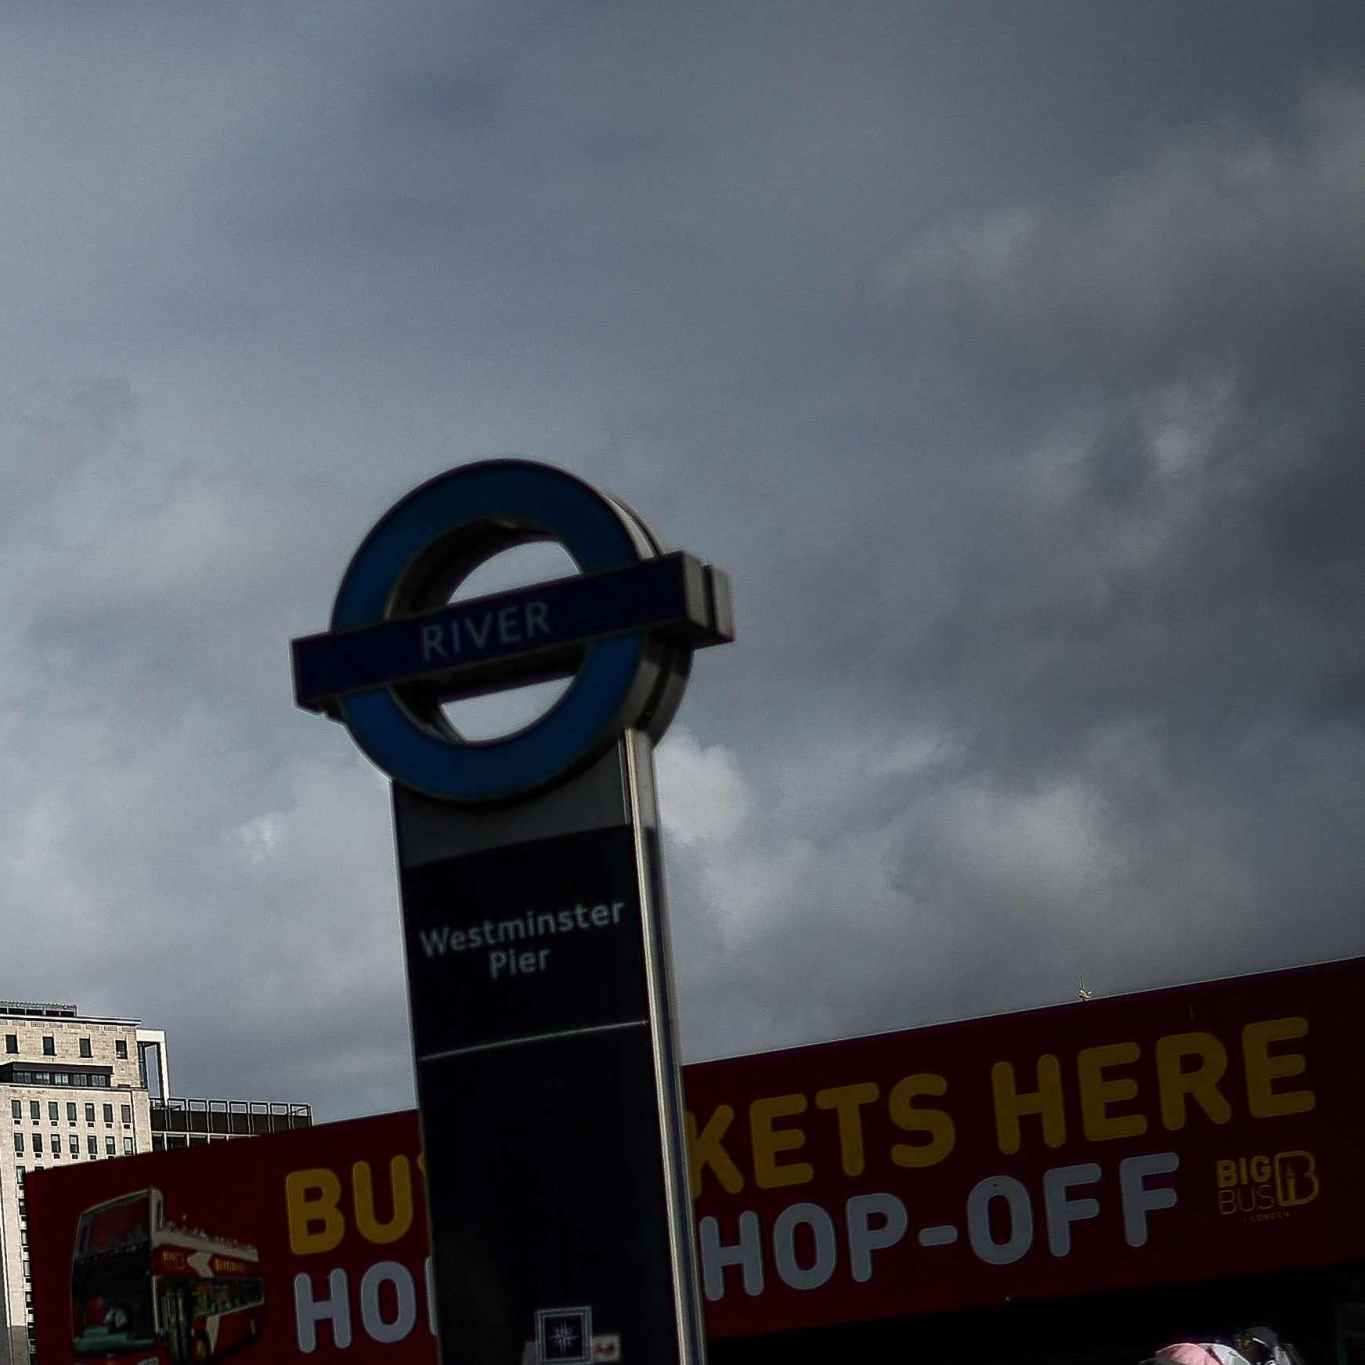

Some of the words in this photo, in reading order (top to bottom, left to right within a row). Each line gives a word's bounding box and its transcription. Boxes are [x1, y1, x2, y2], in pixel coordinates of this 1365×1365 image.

[420, 602, 552, 661] RIVER
[420, 901, 624, 958] Westminster
[490, 948, 551, 979] Pier
[285, 1154, 426, 1256] BU
[685, 1073, 957, 1197] KETS
[990, 1016, 1316, 1155] HERE
[1215, 1154, 1272, 1188] BIG
[1218, 1184, 1275, 1215] BUS
[294, 1257, 437, 1353] HO
[699, 1152, 1180, 1301] HOP-OFF
